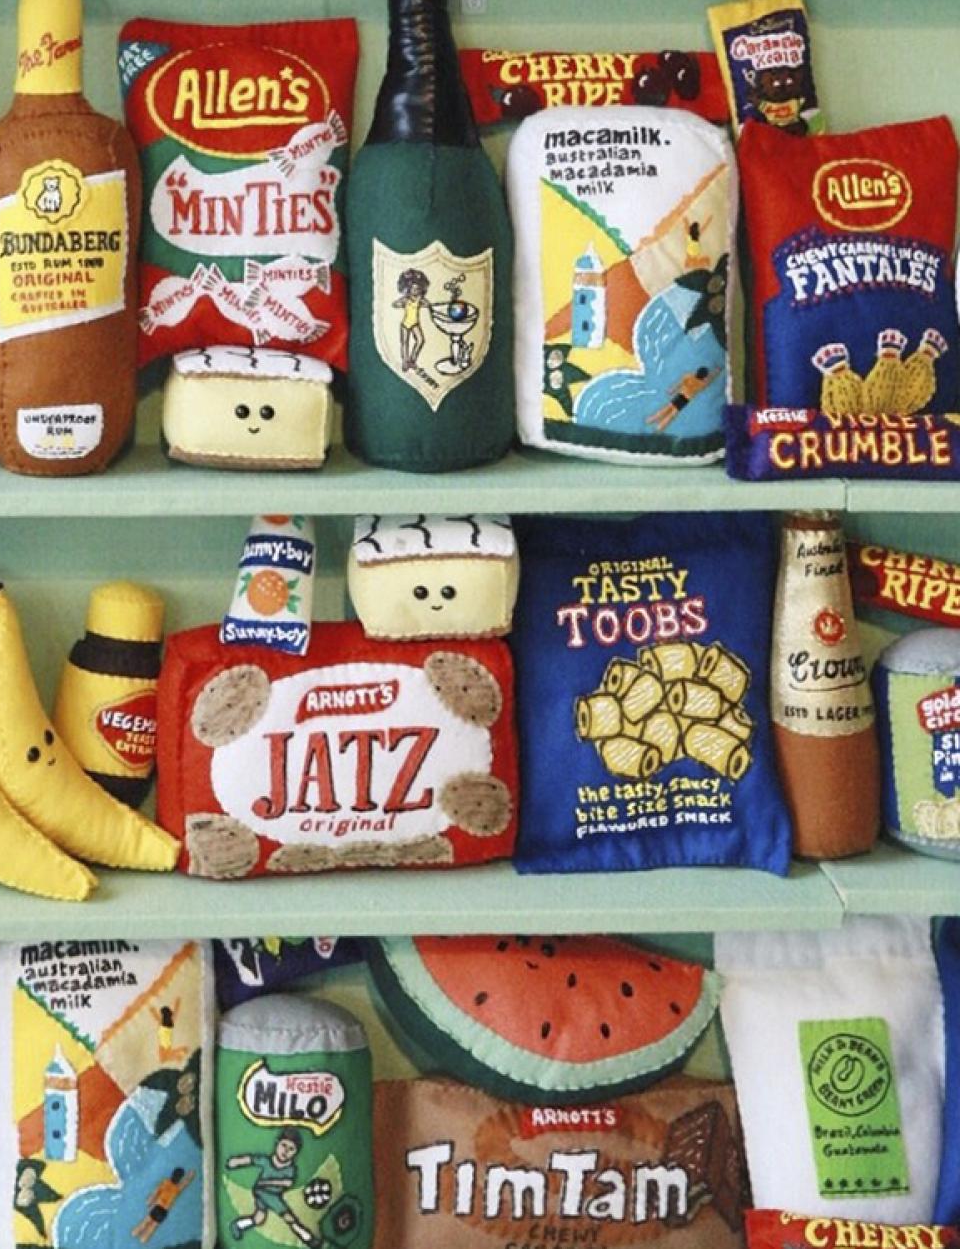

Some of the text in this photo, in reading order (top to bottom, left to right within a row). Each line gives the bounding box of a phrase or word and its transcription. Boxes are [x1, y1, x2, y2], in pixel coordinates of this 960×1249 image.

[500, 55, 637, 84] CHERRY
[174, 67, 310, 128] Allen's
[545, 82, 625, 108] RIPE
[545, 128, 670, 149] macamilk.
[545, 148, 641, 165] australian
[550, 165, 658, 180] macadamia
[576, 181, 614, 196] milk
[827, 171, 902, 209] Allen's
[0, 231, 121, 257] BUNDABERG
[787, 243, 838, 268] CHEWY
[43, 258, 74, 271] RUM
[789, 252, 938, 300] FANTALES
[12, 271, 95, 288] ORIGINAL
[770, 432, 950, 470] CRUMBLE
[589, 558, 672, 575] ORIGINAL
[573, 571, 689, 603] TASTY
[881, 570, 960, 615] RIPE
[557, 599, 708, 647] TOOBS
[306, 684, 394, 709] ARNOTT'S
[817, 706, 860, 721] LAGER
[252, 727, 438, 818] JATZ
[578, 778, 720, 802] the saucy
[577, 794, 732, 822] bite size snack
[300, 812, 397, 837] original
[25, 960, 122, 980] australian
[33, 973, 138, 992] macadamia
[50, 995, 91, 1009] milk
[254, 1080, 328, 1119] MILO
[532, 1108, 616, 1126] ARNOTT'S
[805, 1219, 945, 1248] CHERRY
